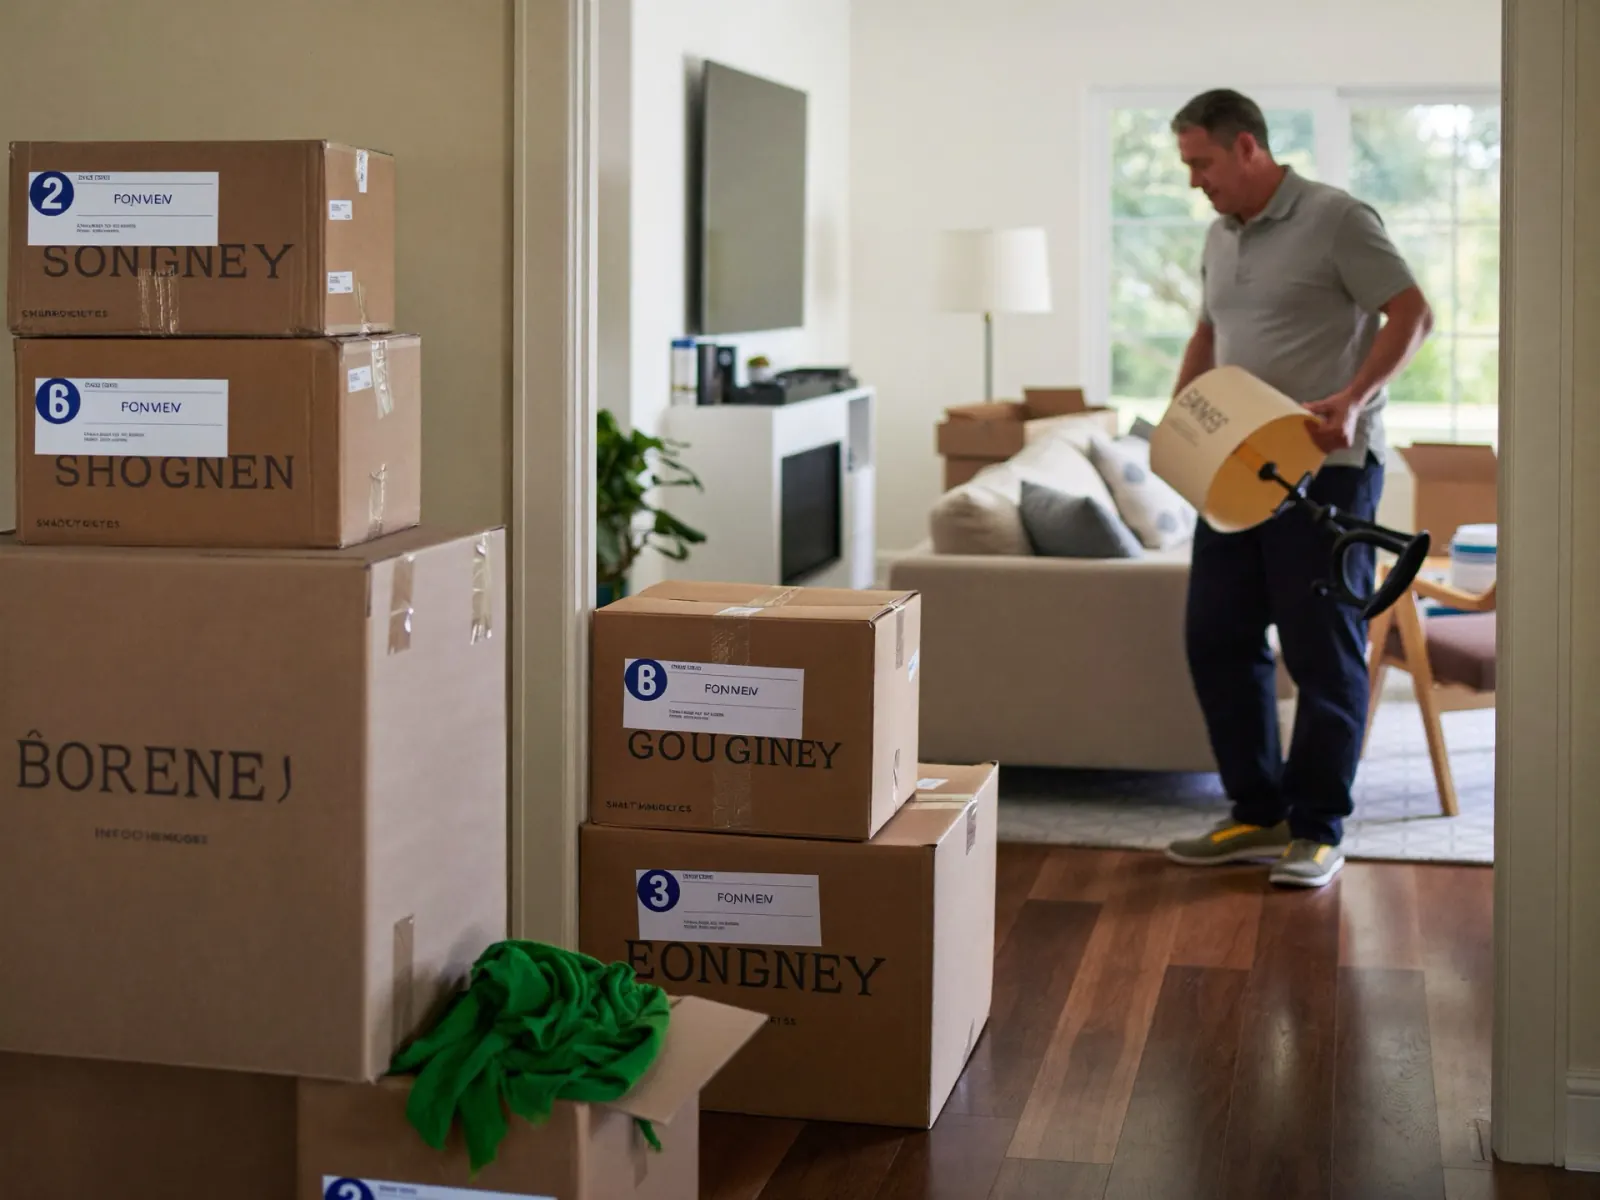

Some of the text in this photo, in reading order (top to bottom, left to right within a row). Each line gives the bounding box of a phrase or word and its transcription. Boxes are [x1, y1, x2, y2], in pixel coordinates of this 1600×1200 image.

[41, 176, 64, 211] 2
[48, 382, 70, 420] 6
[649, 874, 670, 908] 3
